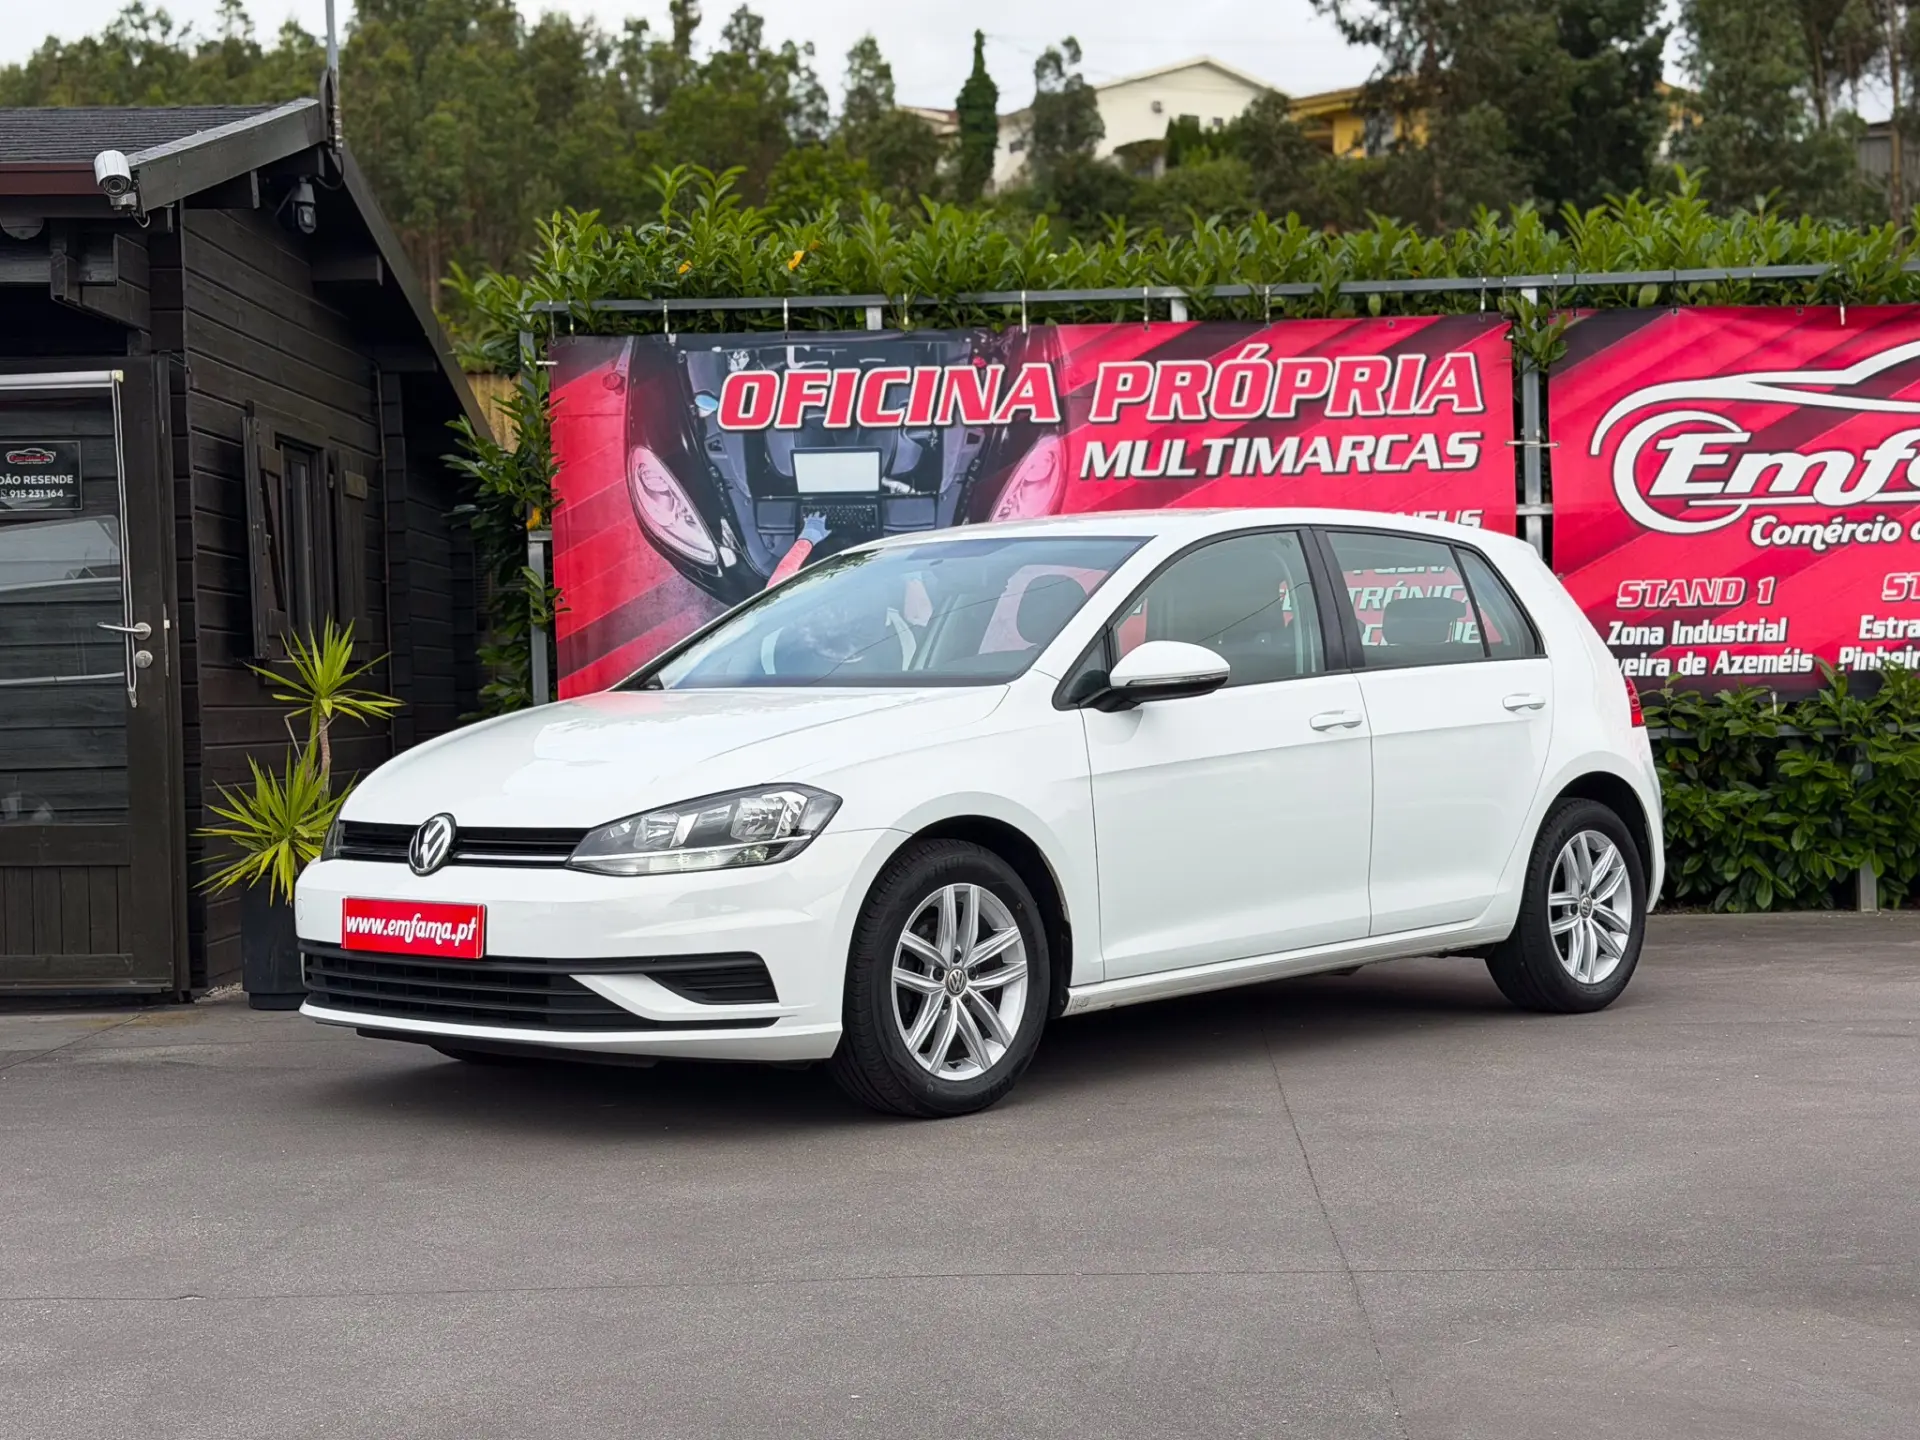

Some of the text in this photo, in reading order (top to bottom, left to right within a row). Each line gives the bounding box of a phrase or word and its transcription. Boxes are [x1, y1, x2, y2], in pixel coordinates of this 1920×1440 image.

[717, 343, 1484, 430] OFICINA PRÓPRIA
[1079, 431, 1482, 478] MULTIMARCAS
[9, 489, 64, 498] 915 231 164
[23, 474, 74, 485] RESENDE
[1750, 514, 1902, 550] Comércio
[1616, 576, 1775, 608] STAND 1
[1606, 617, 1788, 646] Zona Industrial
[1677, 651, 1707, 676] de
[1712, 647, 1814, 675] Azeméis
[346, 913, 477, 947] www.emfama.pt
